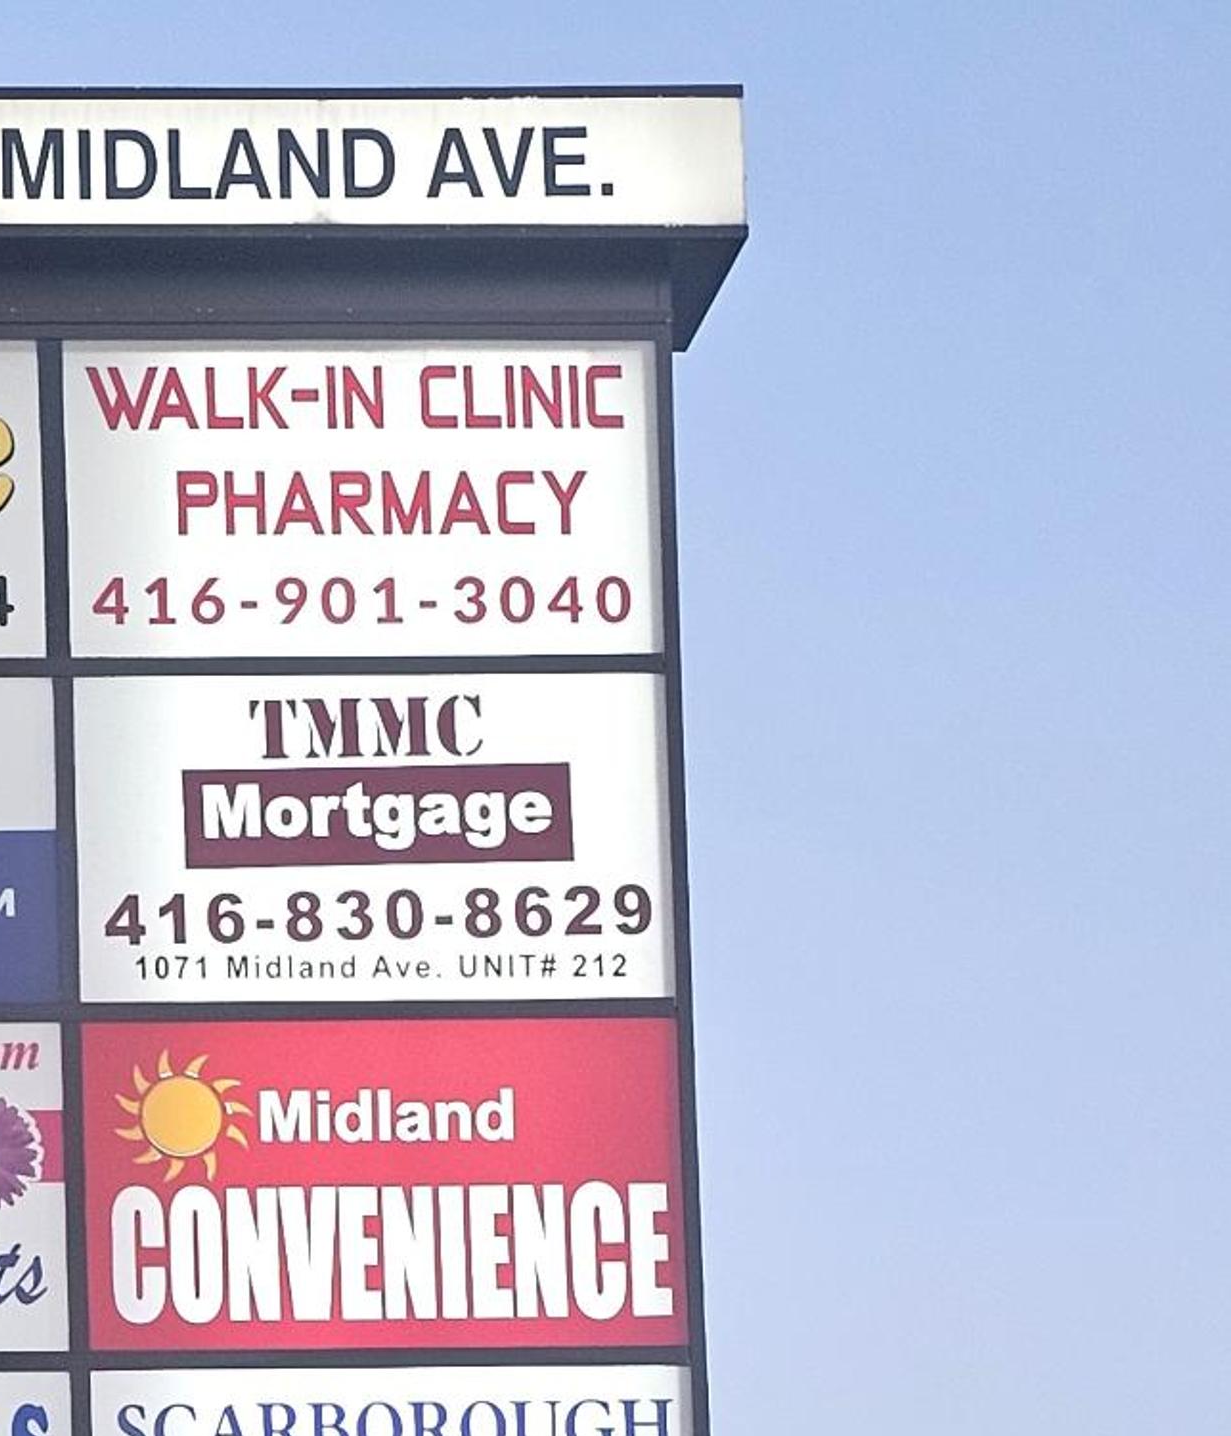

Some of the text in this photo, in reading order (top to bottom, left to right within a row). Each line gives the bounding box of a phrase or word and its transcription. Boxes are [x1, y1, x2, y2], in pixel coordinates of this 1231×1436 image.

[2, 127, 395, 201] MIDLAND
[427, 126, 615, 197] AVE.
[86, 365, 625, 431] WALK-IN CLINIC
[176, 470, 588, 535] PHARMACY
[93, 575, 631, 625] 416-901-3040
[249, 694, 484, 759] TMMC
[200, 780, 554, 851] Mortgage
[104, 883, 653, 946] 416-830-8629
[135, 952, 628, 980] 1071 Midland Ave. UNIT# 212
[258, 1087, 515, 1143] Midland
[111, 1179, 674, 1325] CONVENIENCE
